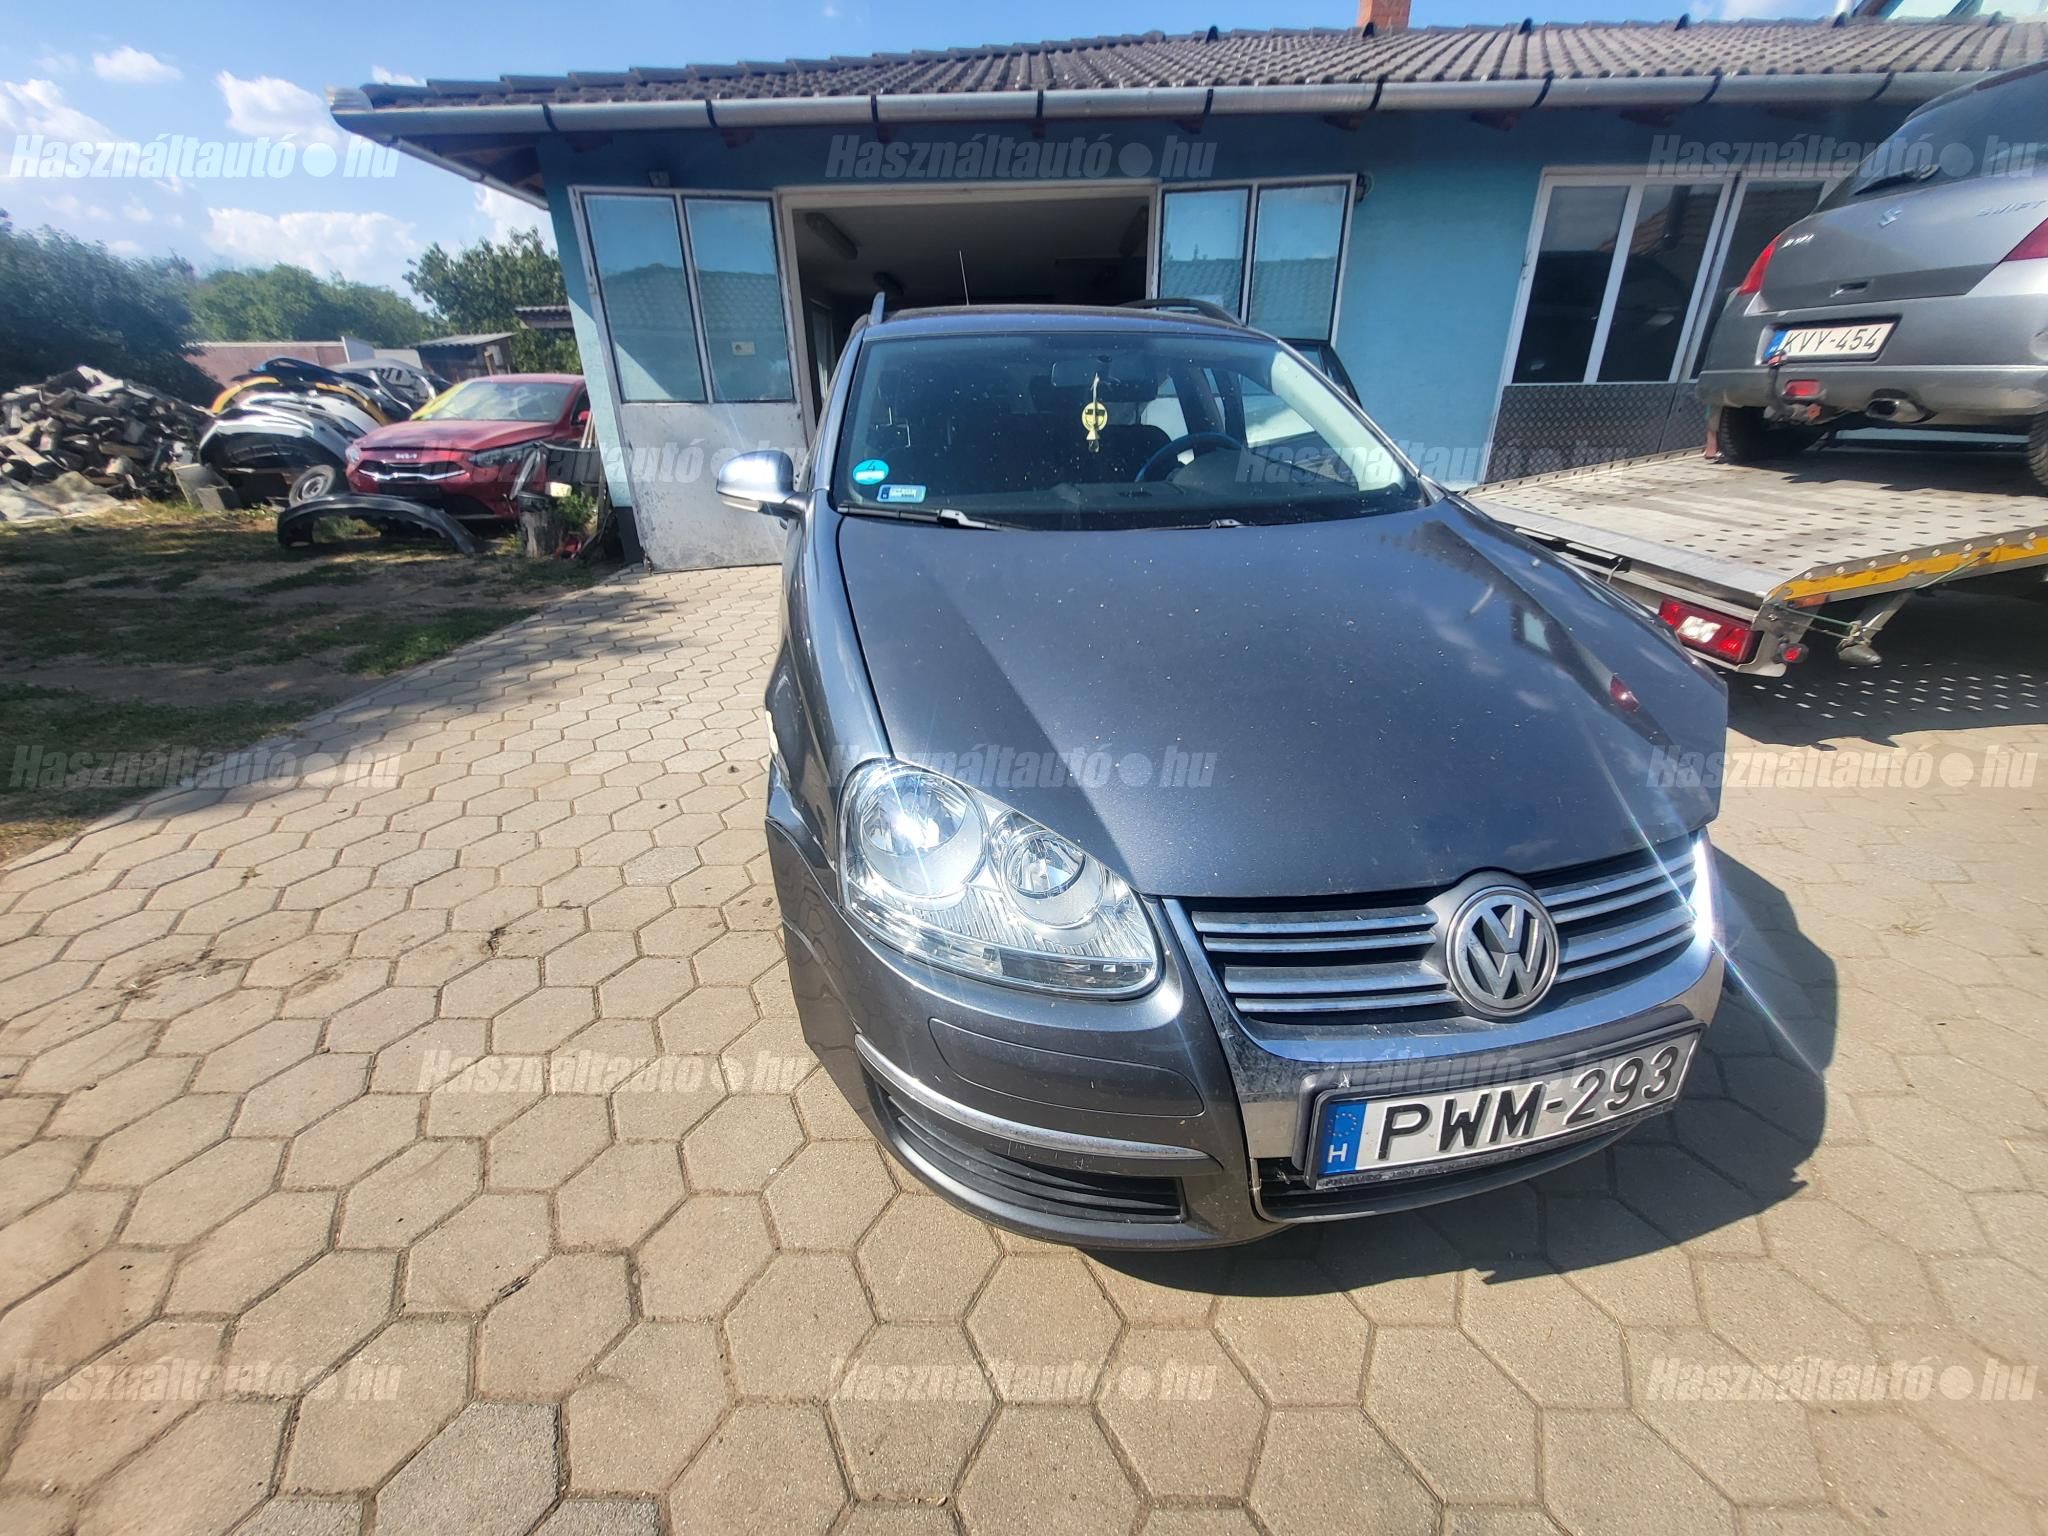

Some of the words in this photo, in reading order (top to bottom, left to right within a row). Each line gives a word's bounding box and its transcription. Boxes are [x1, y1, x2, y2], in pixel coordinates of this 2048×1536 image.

[1782, 327, 1881, 352] KVY-454
[1376, 1045, 1679, 1162] PWM-293
[1328, 1143, 1347, 1163] H
